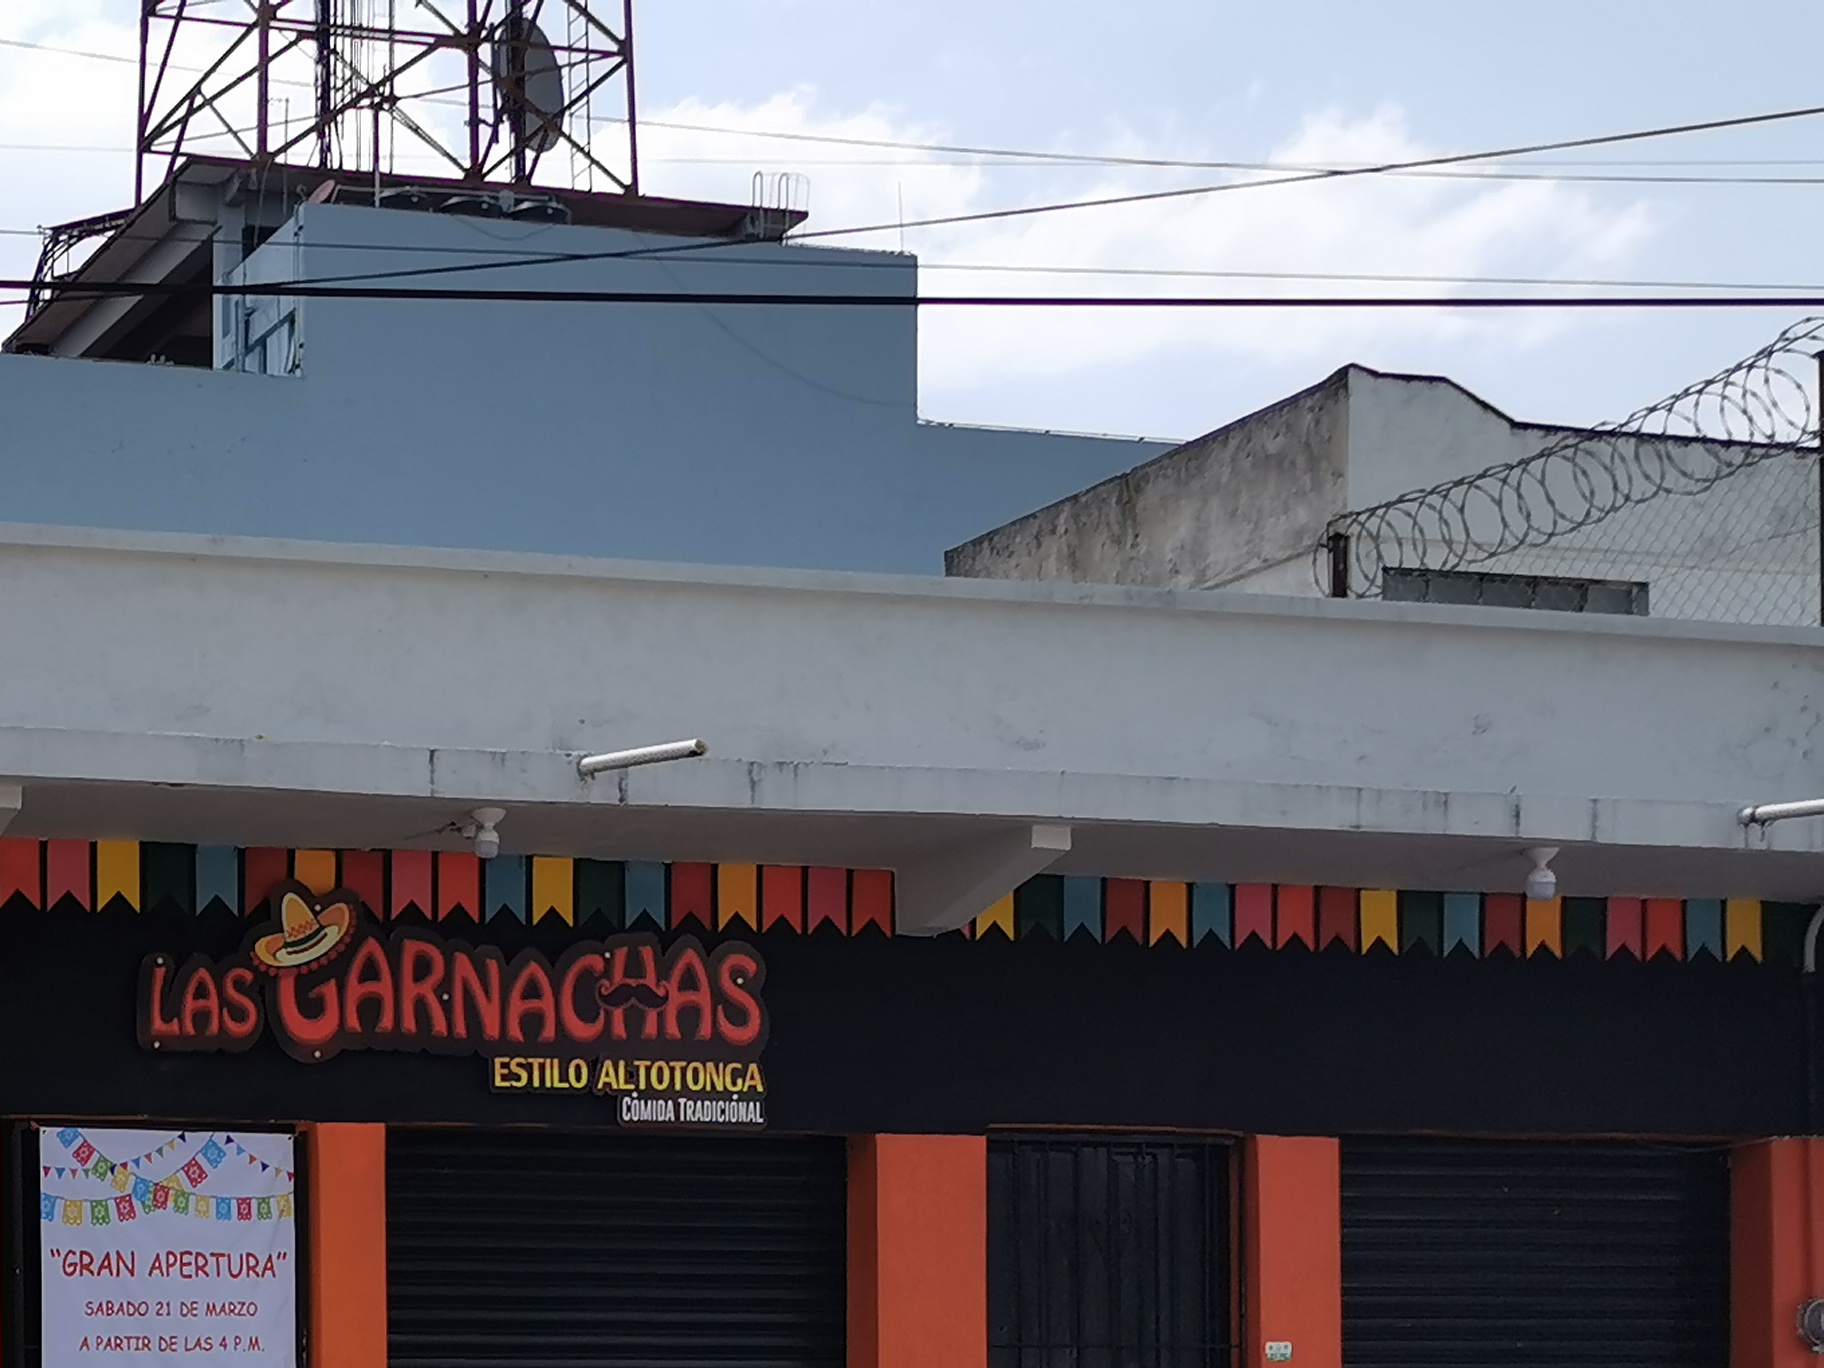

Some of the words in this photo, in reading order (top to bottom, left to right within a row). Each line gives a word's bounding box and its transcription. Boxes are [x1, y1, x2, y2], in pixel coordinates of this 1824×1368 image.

[149, 965, 258, 1037] LAS
[276, 936, 764, 1045] GARNACHAS
[494, 1057, 588, 1089] ESTILO
[597, 1059, 765, 1092] ALTOTONGA
[622, 1096, 675, 1122] COMIDA
[50, 1248, 136, 1278] "GRAN
[148, 1251, 288, 1279] APERTURA"
[84, 1301, 150, 1318] SABADO
[155, 1301, 172, 1317] 21
[179, 1301, 200, 1318] DE
[205, 1302, 259, 1318] MARZO
[78, 1335, 91, 1352] A
[95, 1335, 153, 1352] PARTIR
[158, 1335, 179, 1352] DE
[184, 1335, 214, 1352] LAS
[219, 1335, 228, 1351] 4
[233, 1336, 266, 1352] P.M.
